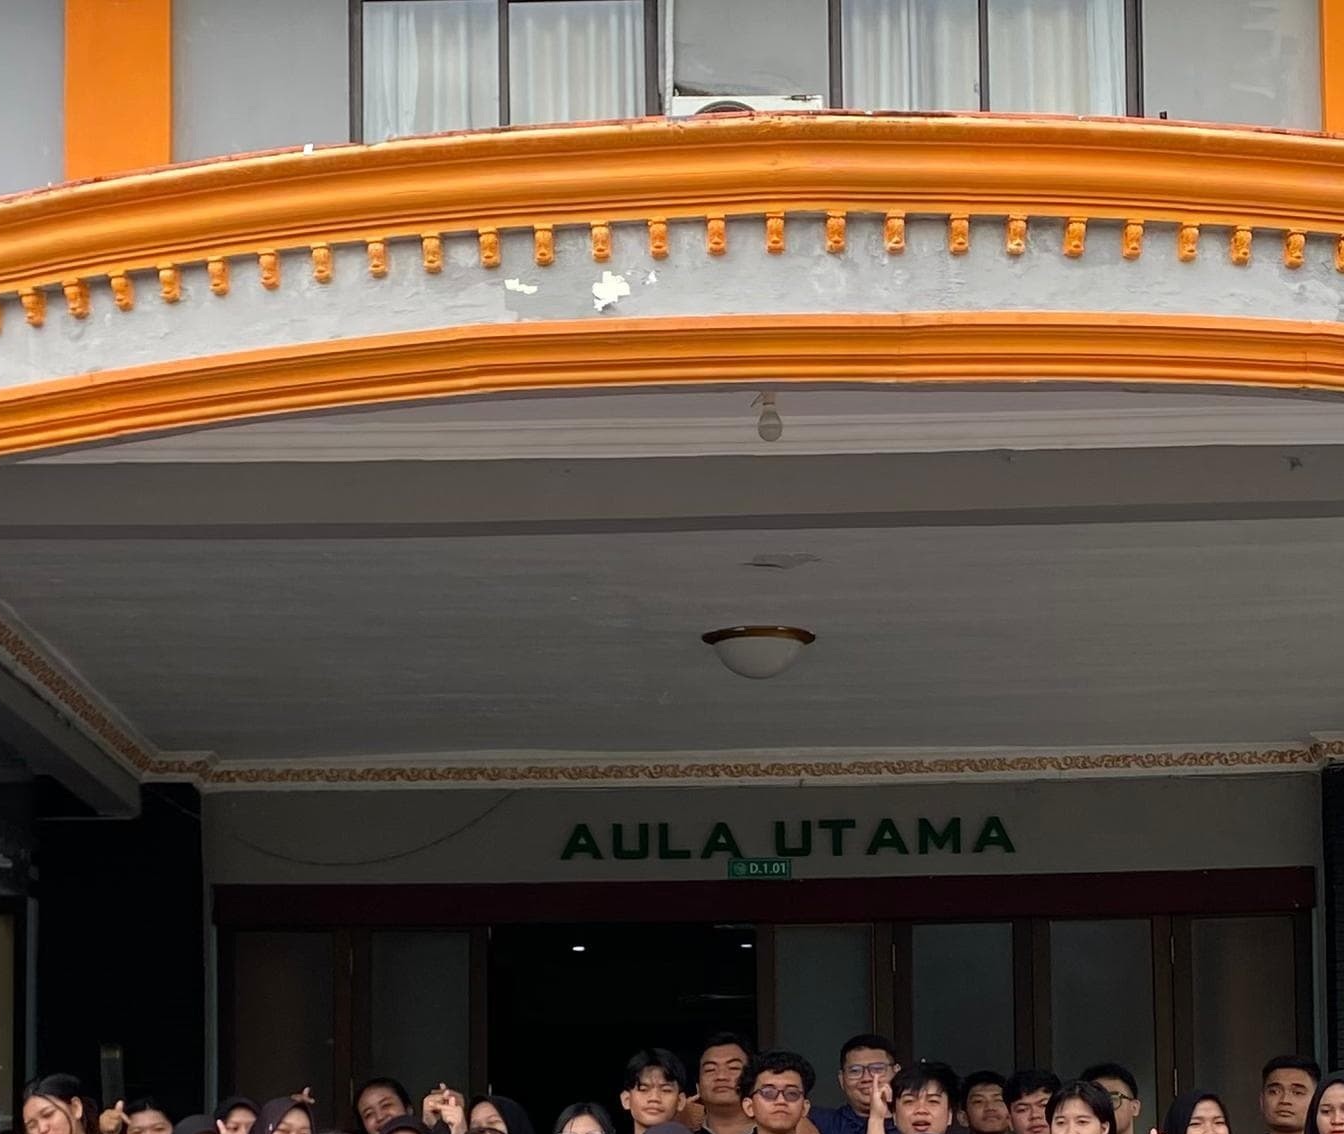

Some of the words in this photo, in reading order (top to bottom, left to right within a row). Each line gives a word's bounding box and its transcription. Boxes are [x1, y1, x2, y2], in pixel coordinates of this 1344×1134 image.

[560, 821, 743, 860] AULA
[774, 815, 1016, 857] UTAMA
[749, 862, 786, 875] D.1.01
